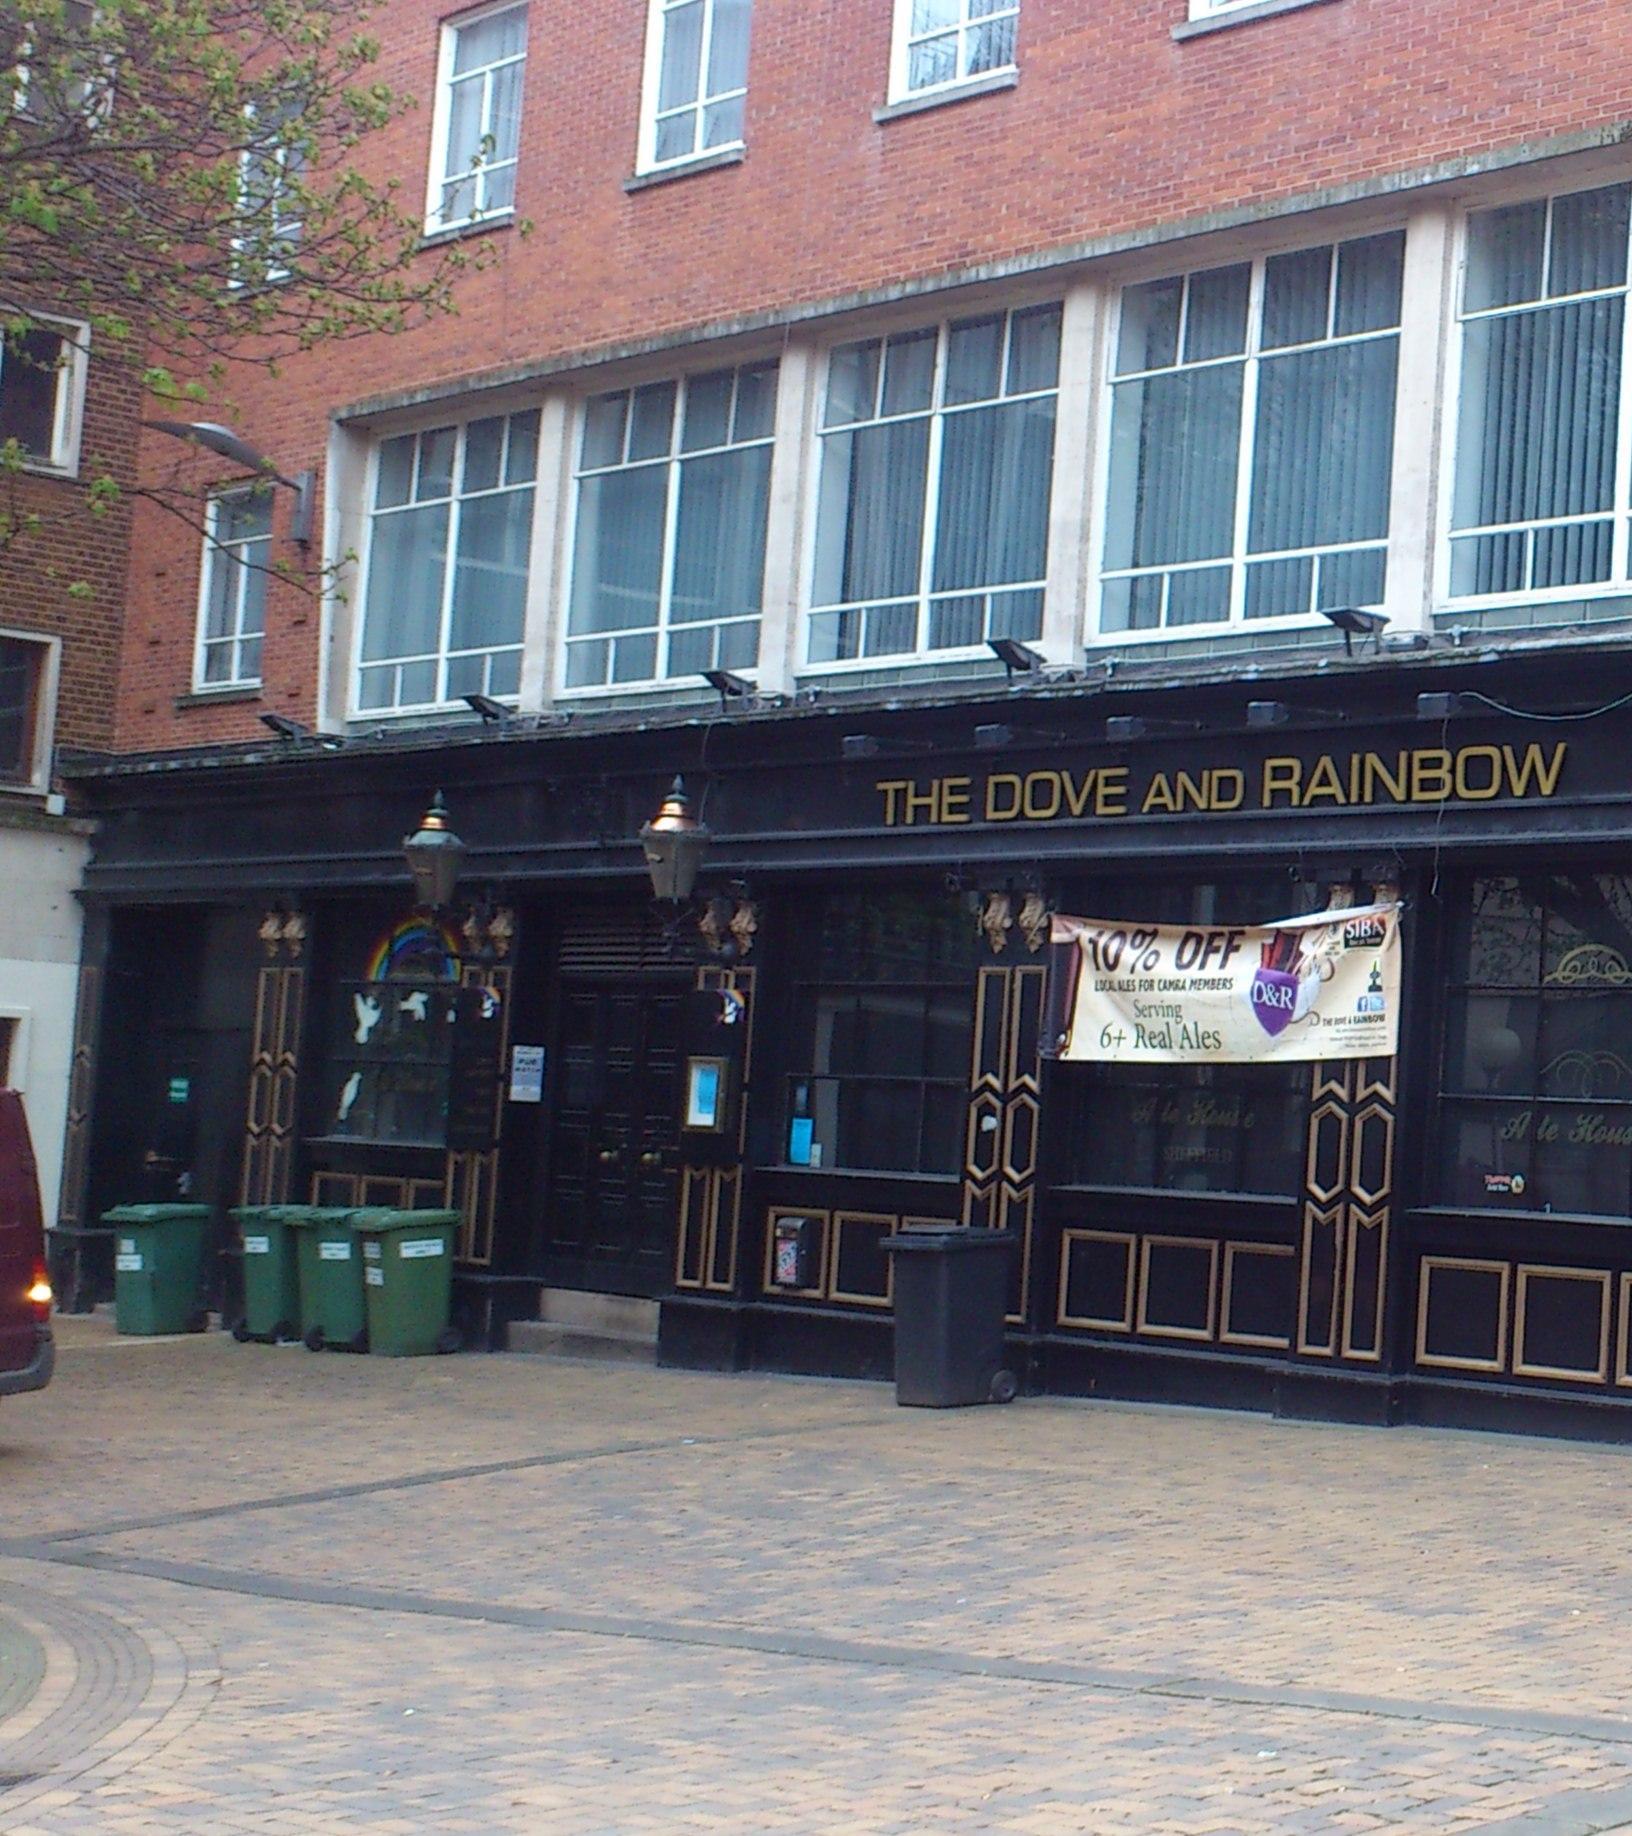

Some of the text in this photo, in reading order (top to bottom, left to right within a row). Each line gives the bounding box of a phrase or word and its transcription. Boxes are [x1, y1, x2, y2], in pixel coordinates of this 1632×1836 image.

[876, 741, 1568, 826] THE DOVE AND RAINBOW
[1346, 918, 1385, 938] SIBA
[1088, 928, 1245, 974] 10% OFF
[1138, 979, 1155, 992] FOR
[1157, 978, 1187, 992] CAMRA
[1188, 977, 1234, 991] MEMBERS
[1253, 980, 1294, 1010] D&R
[1133, 998, 1183, 1025] Serving
[1099, 1021, 1222, 1049] 6+ Real Ales
